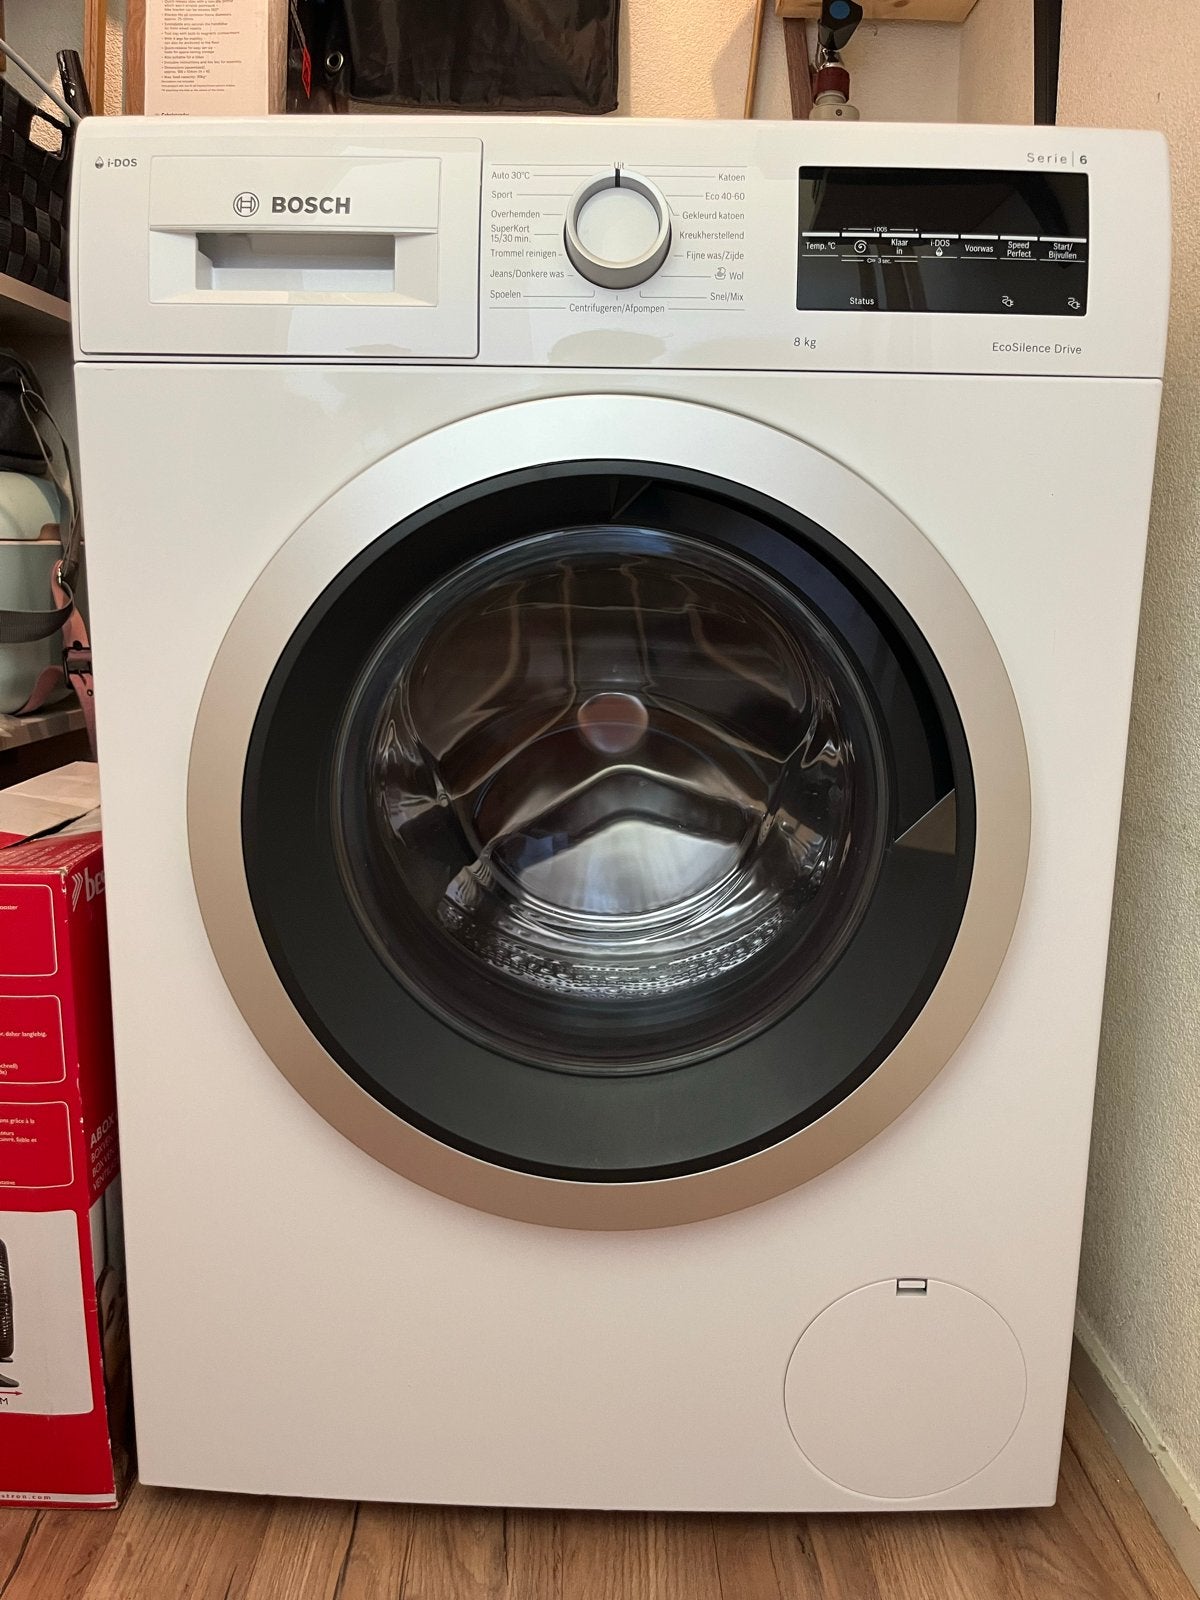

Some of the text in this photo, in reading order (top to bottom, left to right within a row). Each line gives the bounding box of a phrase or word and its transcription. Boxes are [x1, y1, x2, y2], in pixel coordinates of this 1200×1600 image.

[107, 158, 138, 168] i-DOS
[1027, 152, 1088, 165] Serie 6
[491, 171, 530, 180] Auto 30°C
[718, 172, 746, 182] Katoen
[491, 190, 513, 201] Sport
[705, 191, 746, 201] Eco 40-60
[271, 196, 351, 214] BOSCH
[491, 209, 541, 219] Overhemden
[682, 210, 745, 220] Gekleurd katoen
[491, 224, 530, 235] SuperKort
[491, 234, 532, 243] 15/30 min.
[679, 230, 745, 240] Kreukherstellend
[805, 241, 828, 252] Temp.
[891, 238, 909, 247] Klaar
[930, 239, 951, 247] i-DOS
[1007, 240, 1031, 251] Speed
[1053, 242, 1073, 253] Start/
[896, 247, 904, 255] in
[964, 243, 994, 253] Voorwas
[490, 248, 557, 260] Trommel reinigen
[686, 250, 745, 261] Fijne was/Zijde
[1006, 249, 1032, 259] Perfect
[1048, 251, 1078, 262] Bijvullen
[489, 269, 548, 279] Jeans/Donkere
[729, 271, 744, 280] Wol
[489, 289, 522, 300] Spoelen
[710, 291, 744, 302] Snel/Mix
[849, 297, 876, 306] Status
[569, 302, 665, 314] Centrifugeren/Afpompen
[793, 336, 817, 350] 8 kg
[992, 341, 1083, 355] EcoSilence Drive
